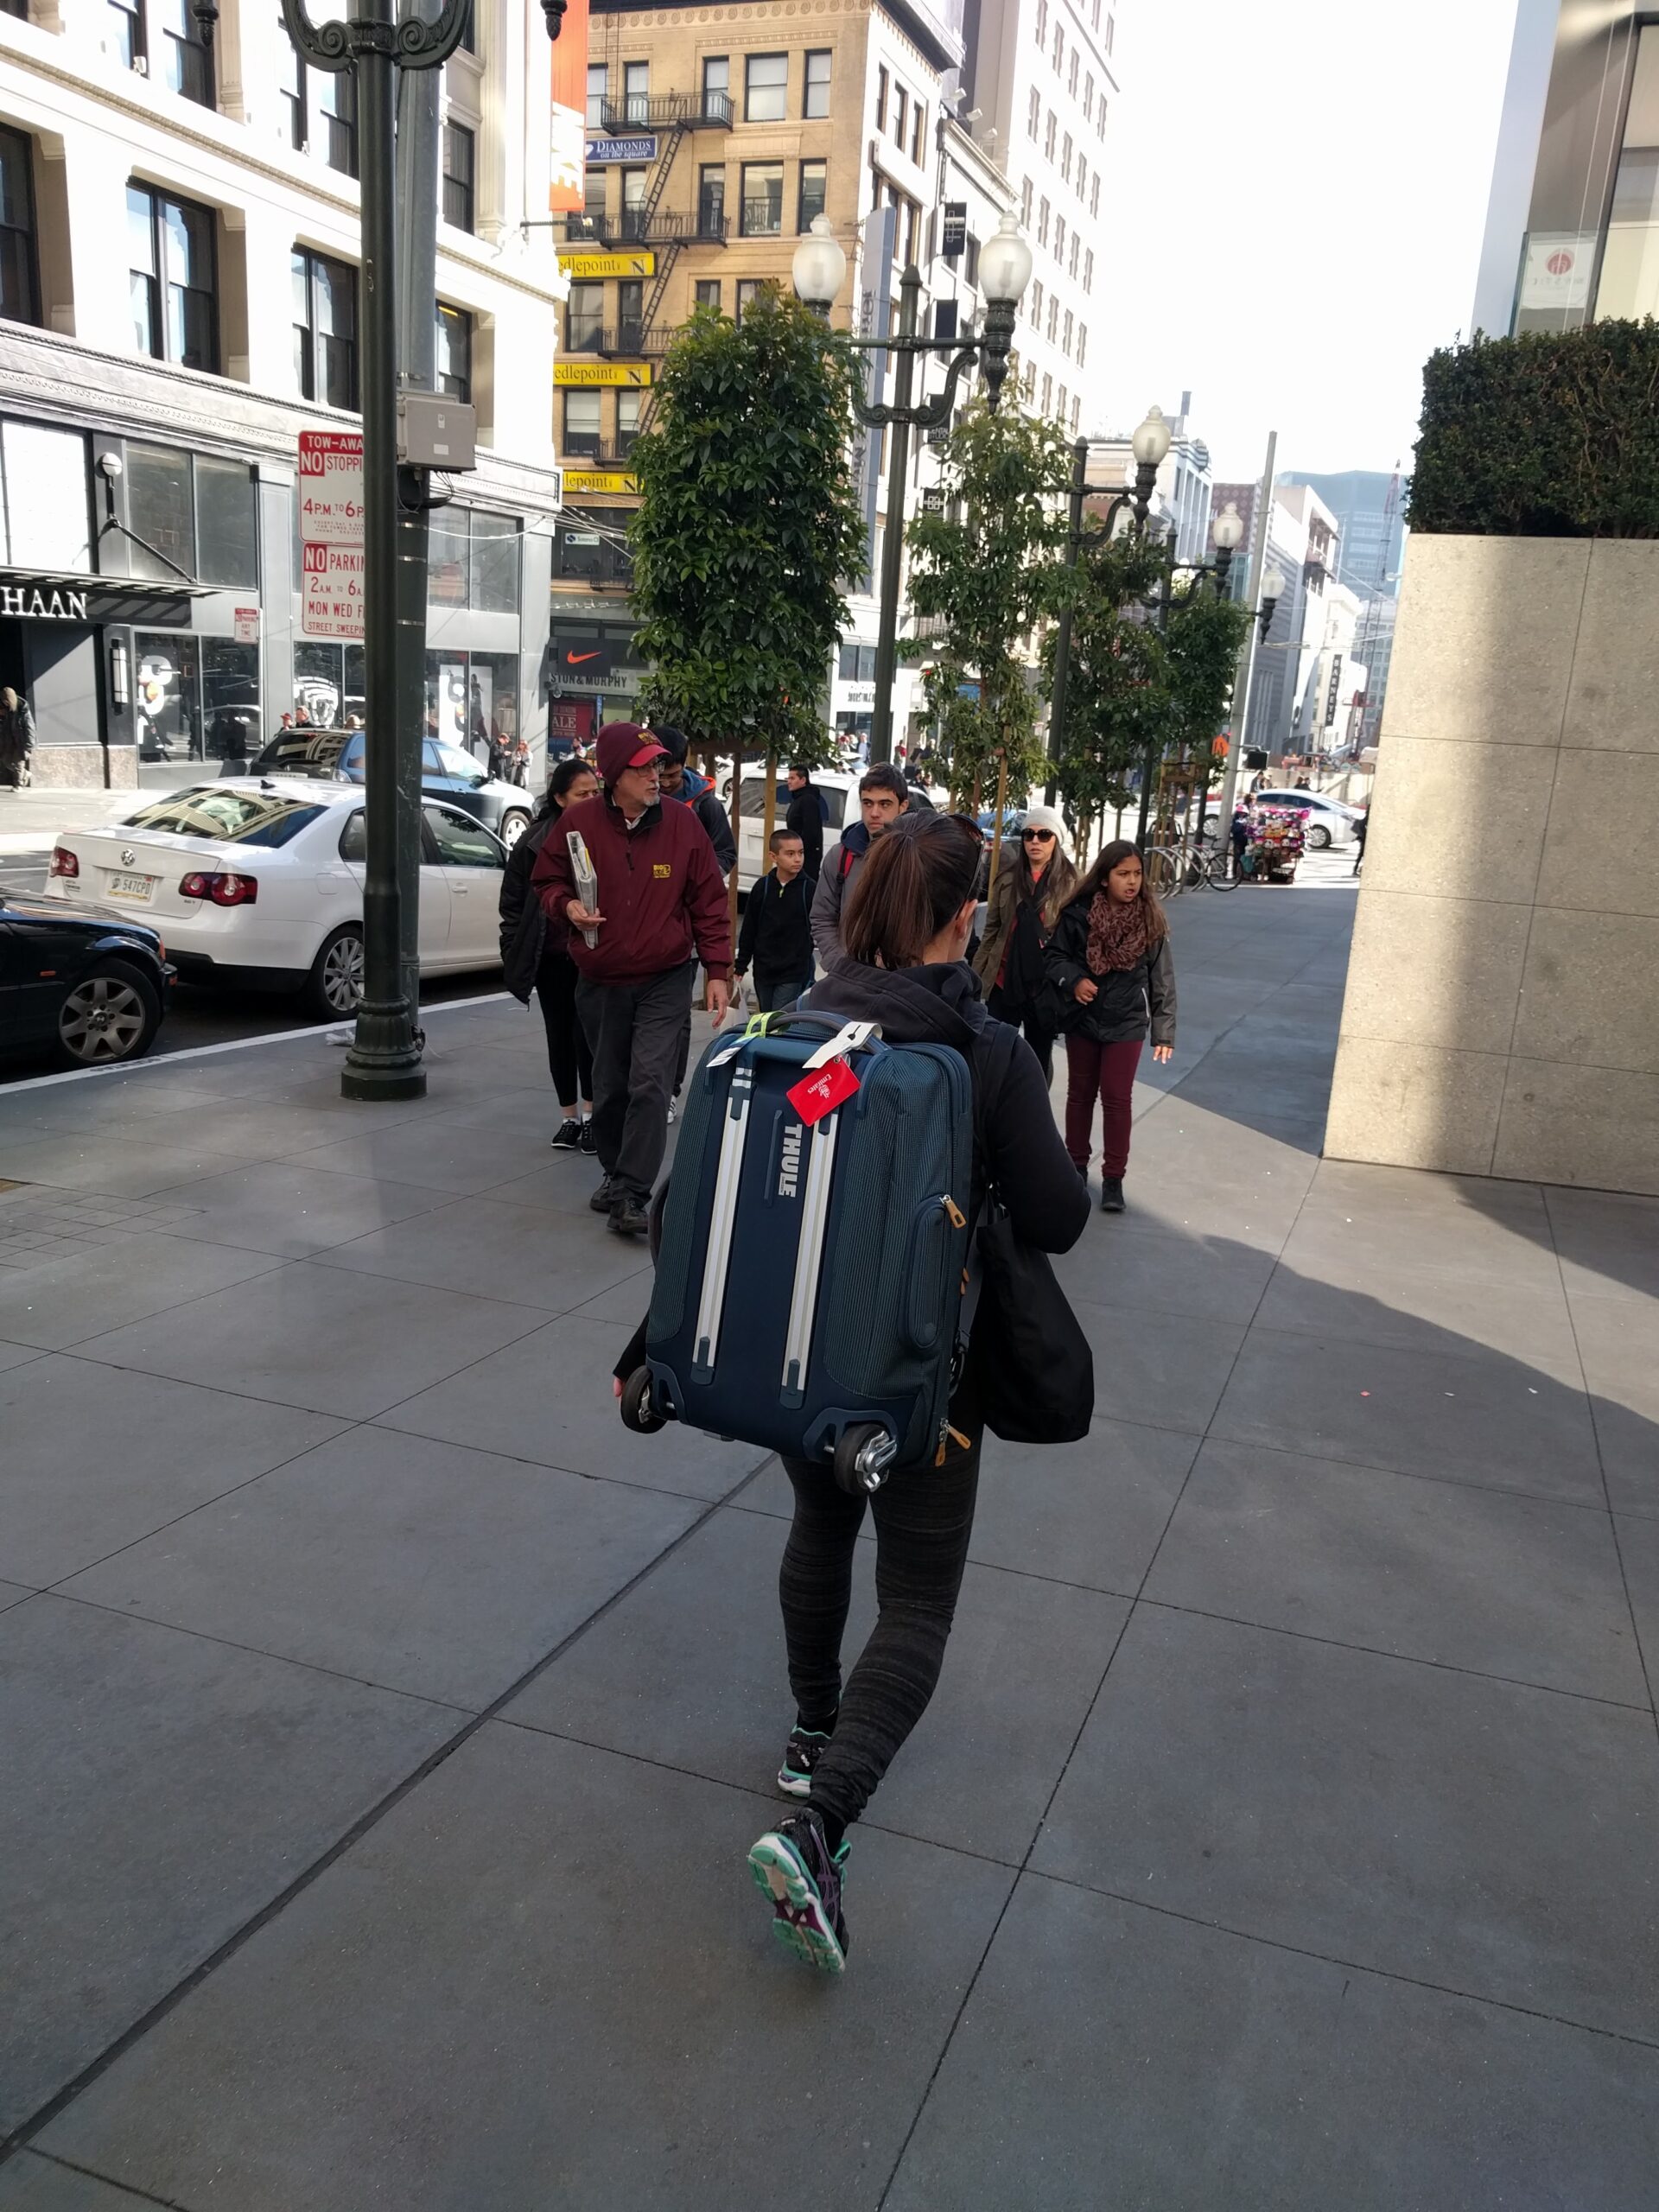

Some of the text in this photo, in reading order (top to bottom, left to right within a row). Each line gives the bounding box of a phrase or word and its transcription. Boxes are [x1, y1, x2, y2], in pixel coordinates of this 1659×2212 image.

[597, 141, 651, 152] DIAMONDS
[301, 451, 323, 473] NO
[305, 547, 326, 571] NO
[0, 587, 87, 620] HAAN
[308, 601, 327, 615] MON
[334, 603, 352, 618] WED
[308, 622, 332, 632] STREET
[1326, 659, 1339, 721] BARNEYS
[808, 1074, 832, 1094] Emirates
[779, 1123, 802, 1198] THULE
